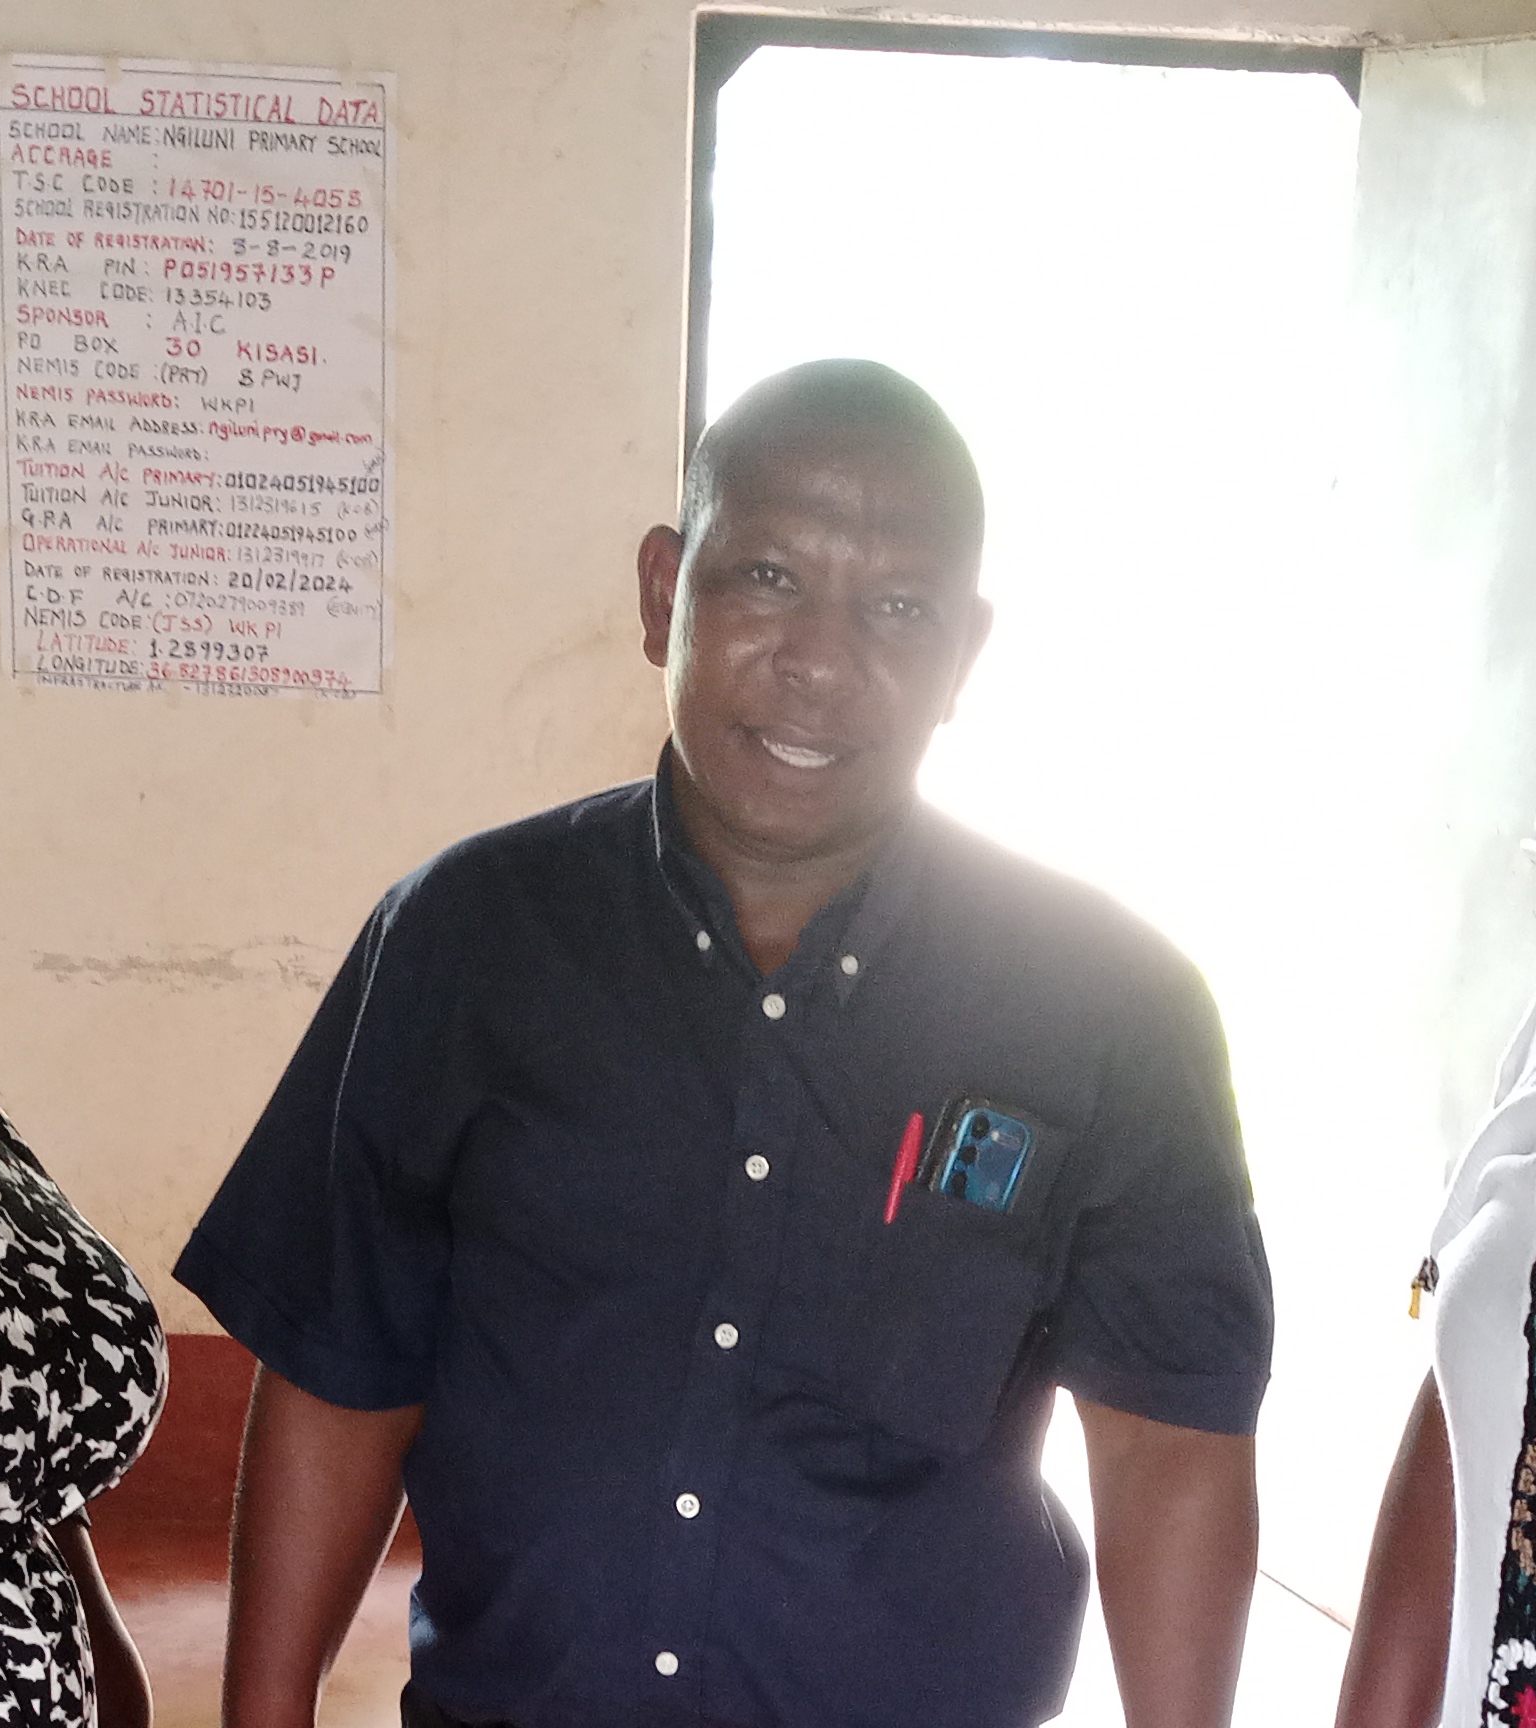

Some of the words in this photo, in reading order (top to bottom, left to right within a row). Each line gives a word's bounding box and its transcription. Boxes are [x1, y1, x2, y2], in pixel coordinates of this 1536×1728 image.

[11, 82, 116, 114] SCHOOL
[140, 88, 296, 124] STATISTICAL
[318, 96, 379, 126] DATA
[8, 120, 84, 141] SCHOOL
[249, 130, 317, 152] PRIMARY
[327, 135, 382, 157] SCHOOL
[82, 174, 134, 194] CODE
[14, 198, 73, 218] SCHOOL
[83, 199, 200, 225] REGISTRATION
[17, 227, 56, 247] DATE
[66, 231, 84, 249] OF
[17, 276, 71, 298] KNEC
[167, 286, 271, 312] 13354103
[17, 304, 109, 328] SPONSOR
[18, 331, 41, 350] PO
[74, 334, 119, 354] BOX
[166, 336, 201, 357] 30
[17, 356, 79, 378] NEMIS
[94, 359, 140, 379] CODE
[17, 383, 73, 401] NEMIS
[67, 414, 116, 432] EMAIL
[68, 438, 113, 456] EMAIL
[16, 458, 85, 478] TUITION
[21, 482, 86, 504] TUITION
[23, 533, 127, 555] OPERATIONAL
[24, 559, 63, 579] DATE
[73, 564, 92, 579] OF
[228, 567, 353, 593] 20/02/2024
[24, 606, 86, 628] NEMIS
